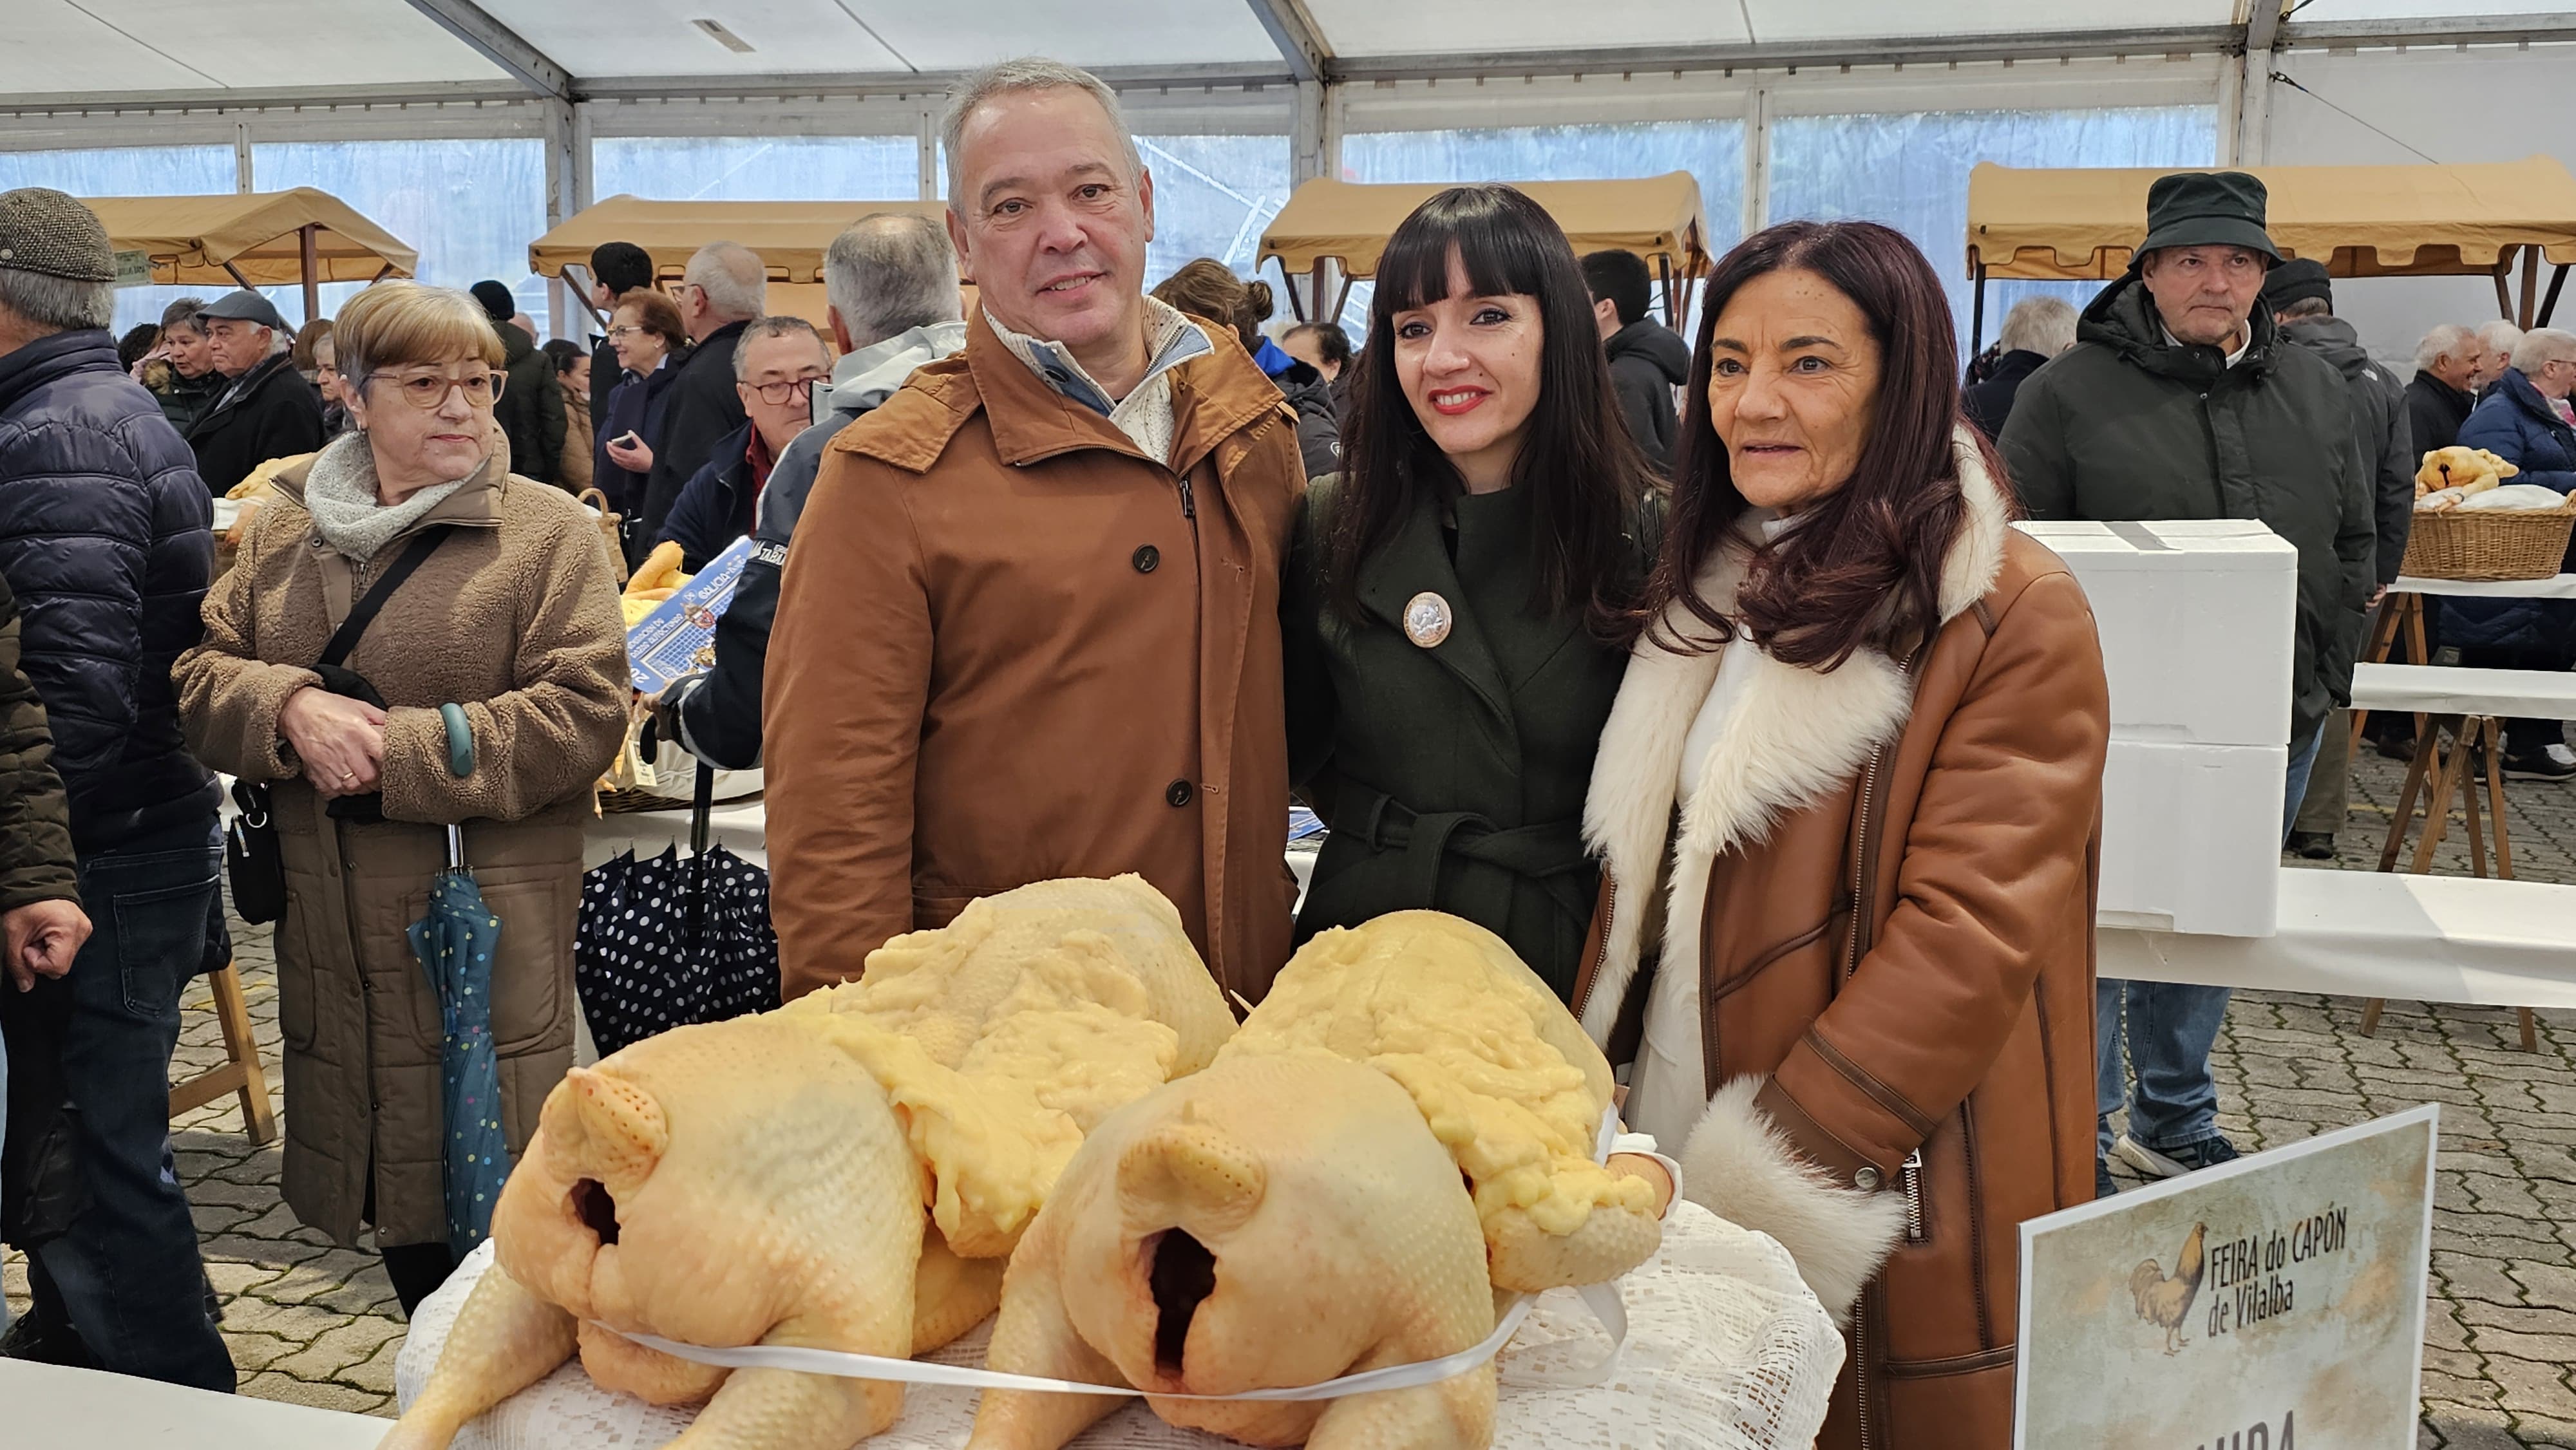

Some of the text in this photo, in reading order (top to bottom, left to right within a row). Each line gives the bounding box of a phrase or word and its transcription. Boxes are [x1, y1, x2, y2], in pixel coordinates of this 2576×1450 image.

[2210, 1201, 2347, 1291] FEIRA do CAPÓN
[2208, 1274, 2293, 1338] de Vilalba
